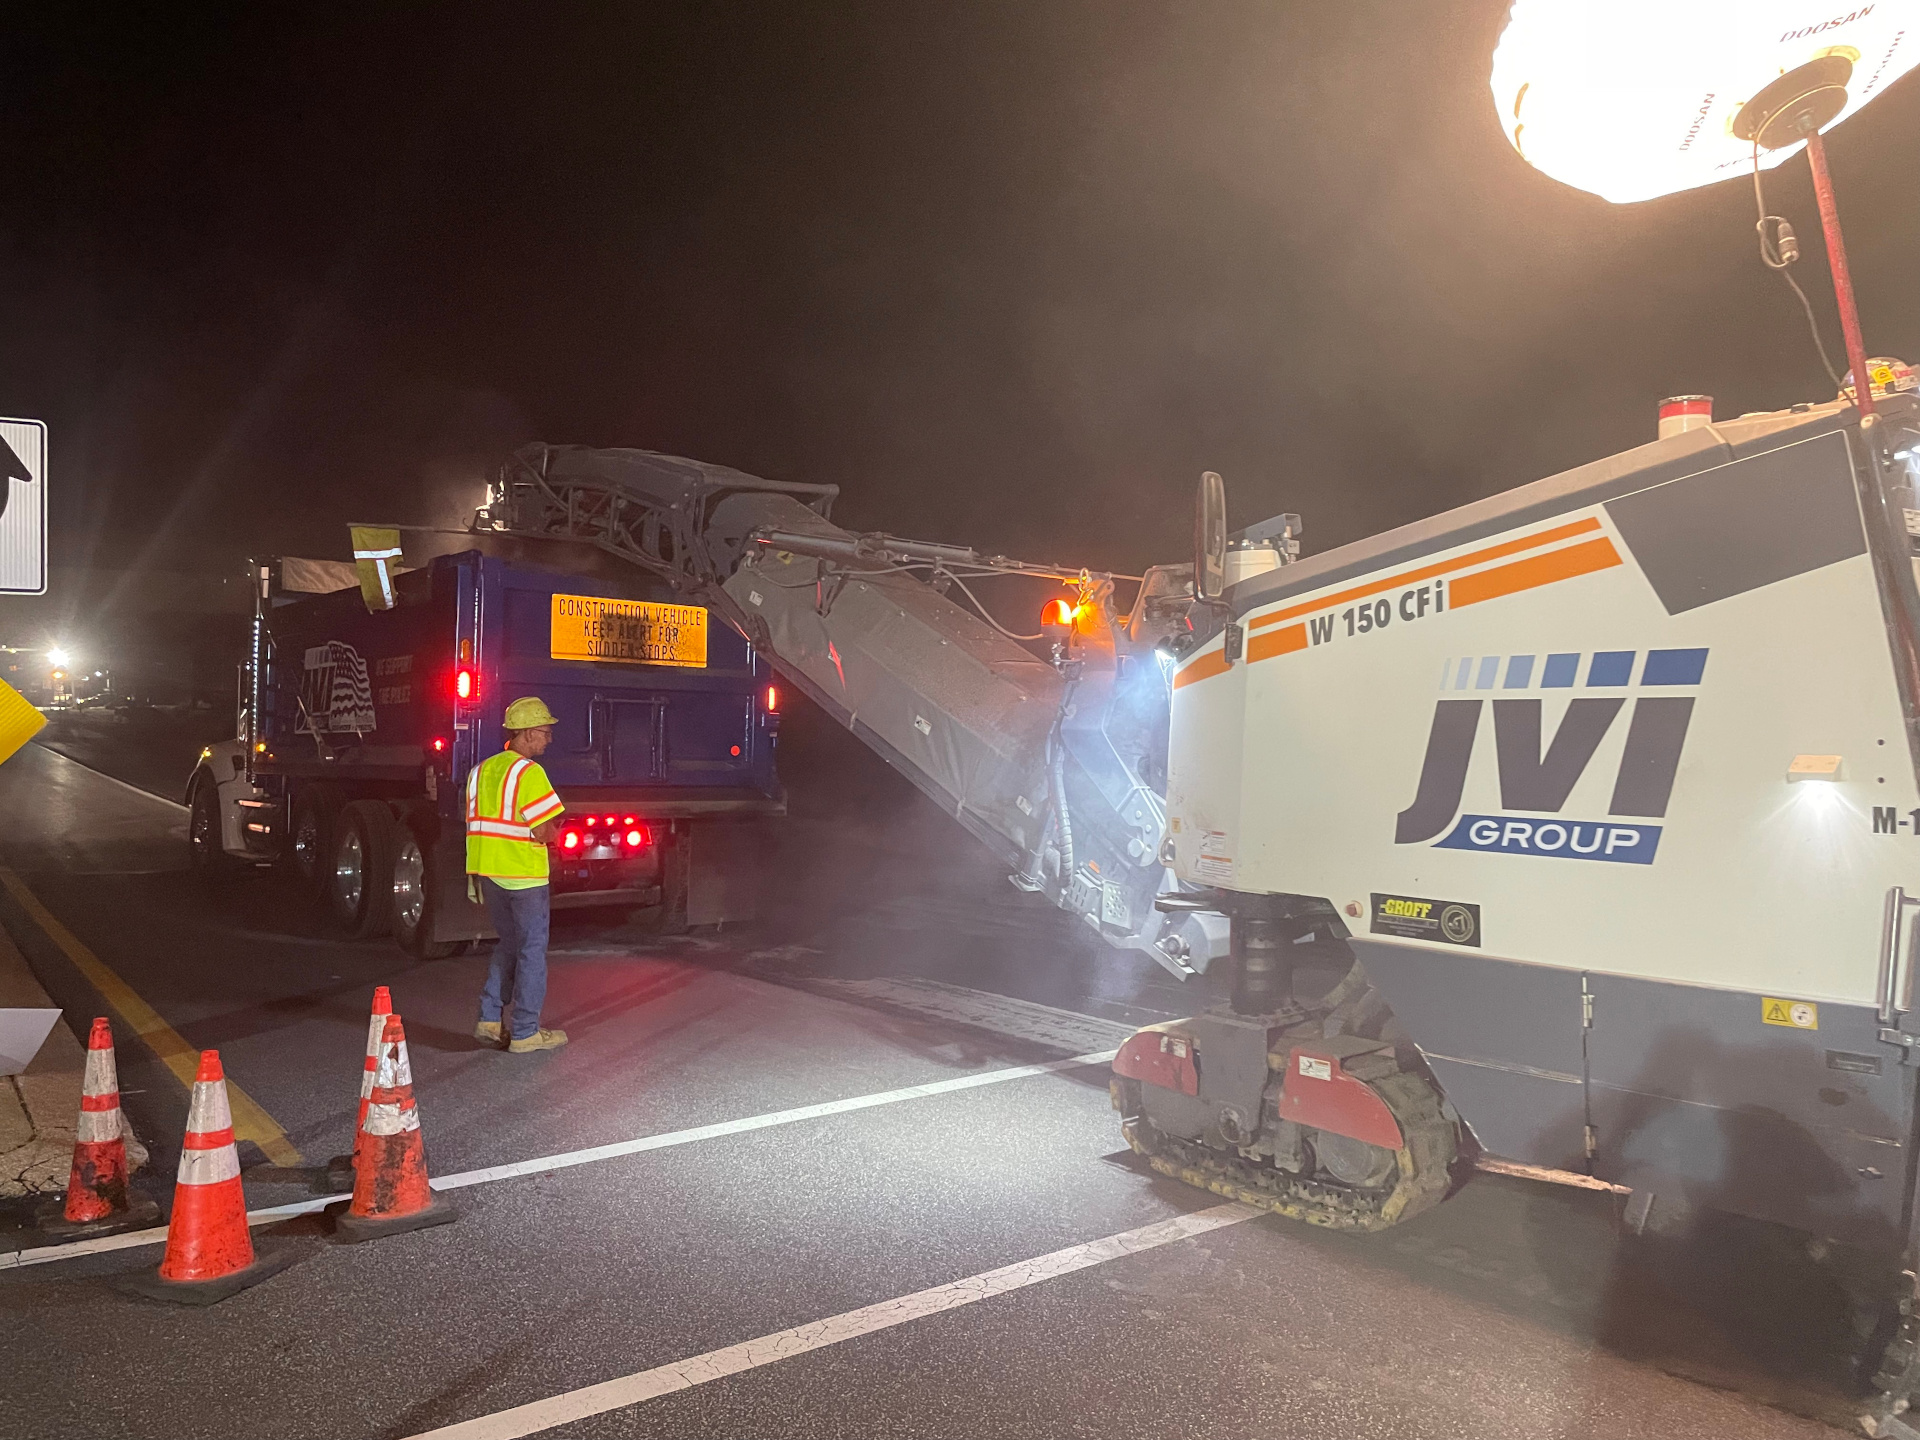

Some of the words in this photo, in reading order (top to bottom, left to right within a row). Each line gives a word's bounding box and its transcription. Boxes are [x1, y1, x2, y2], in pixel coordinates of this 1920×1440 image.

[1779, 3, 1876, 43] DOOSAN
[1678, 93, 1716, 151] DOOSAN
[559, 598, 650, 622] CONSTRUCTION
[655, 606, 701, 627] VEHICLE
[1309, 613, 1335, 646] W
[1342, 598, 1391, 637] 150
[584, 620, 614, 639] KEEP
[618, 622, 653, 641] ALERT
[658, 626, 679, 643] FOR
[587, 640, 635, 659] SUDDEN
[640, 643, 676, 661] STOPS
[1468, 819, 1641, 855] GROUP
[1384, 898, 1433, 918] GROFF
